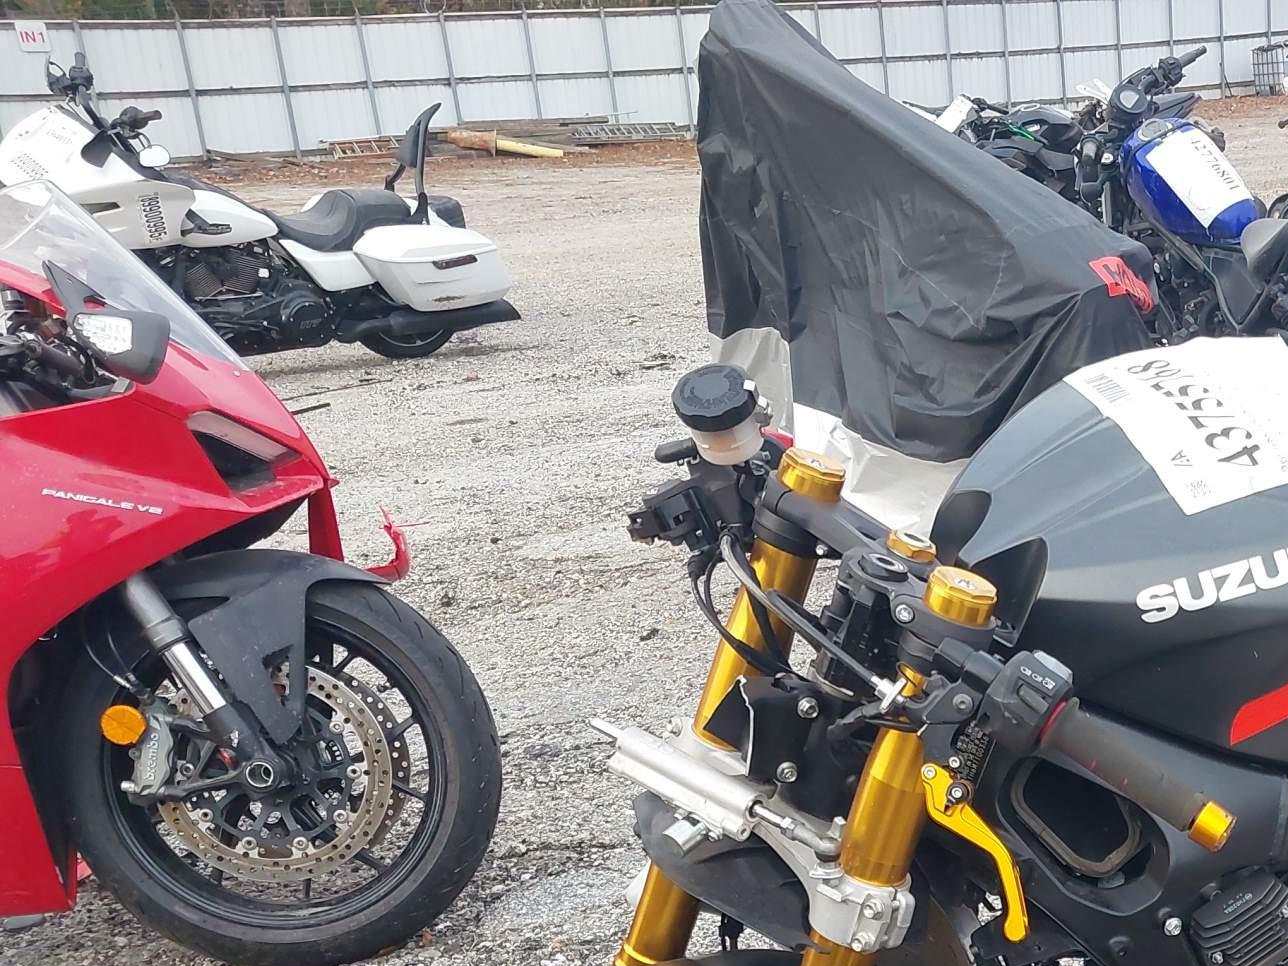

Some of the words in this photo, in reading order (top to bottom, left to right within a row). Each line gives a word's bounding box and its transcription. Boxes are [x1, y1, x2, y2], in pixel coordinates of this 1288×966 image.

[19, 31, 37, 43] IN
[137, 504, 163, 515] V2
[143, 732, 160, 780] brembo
